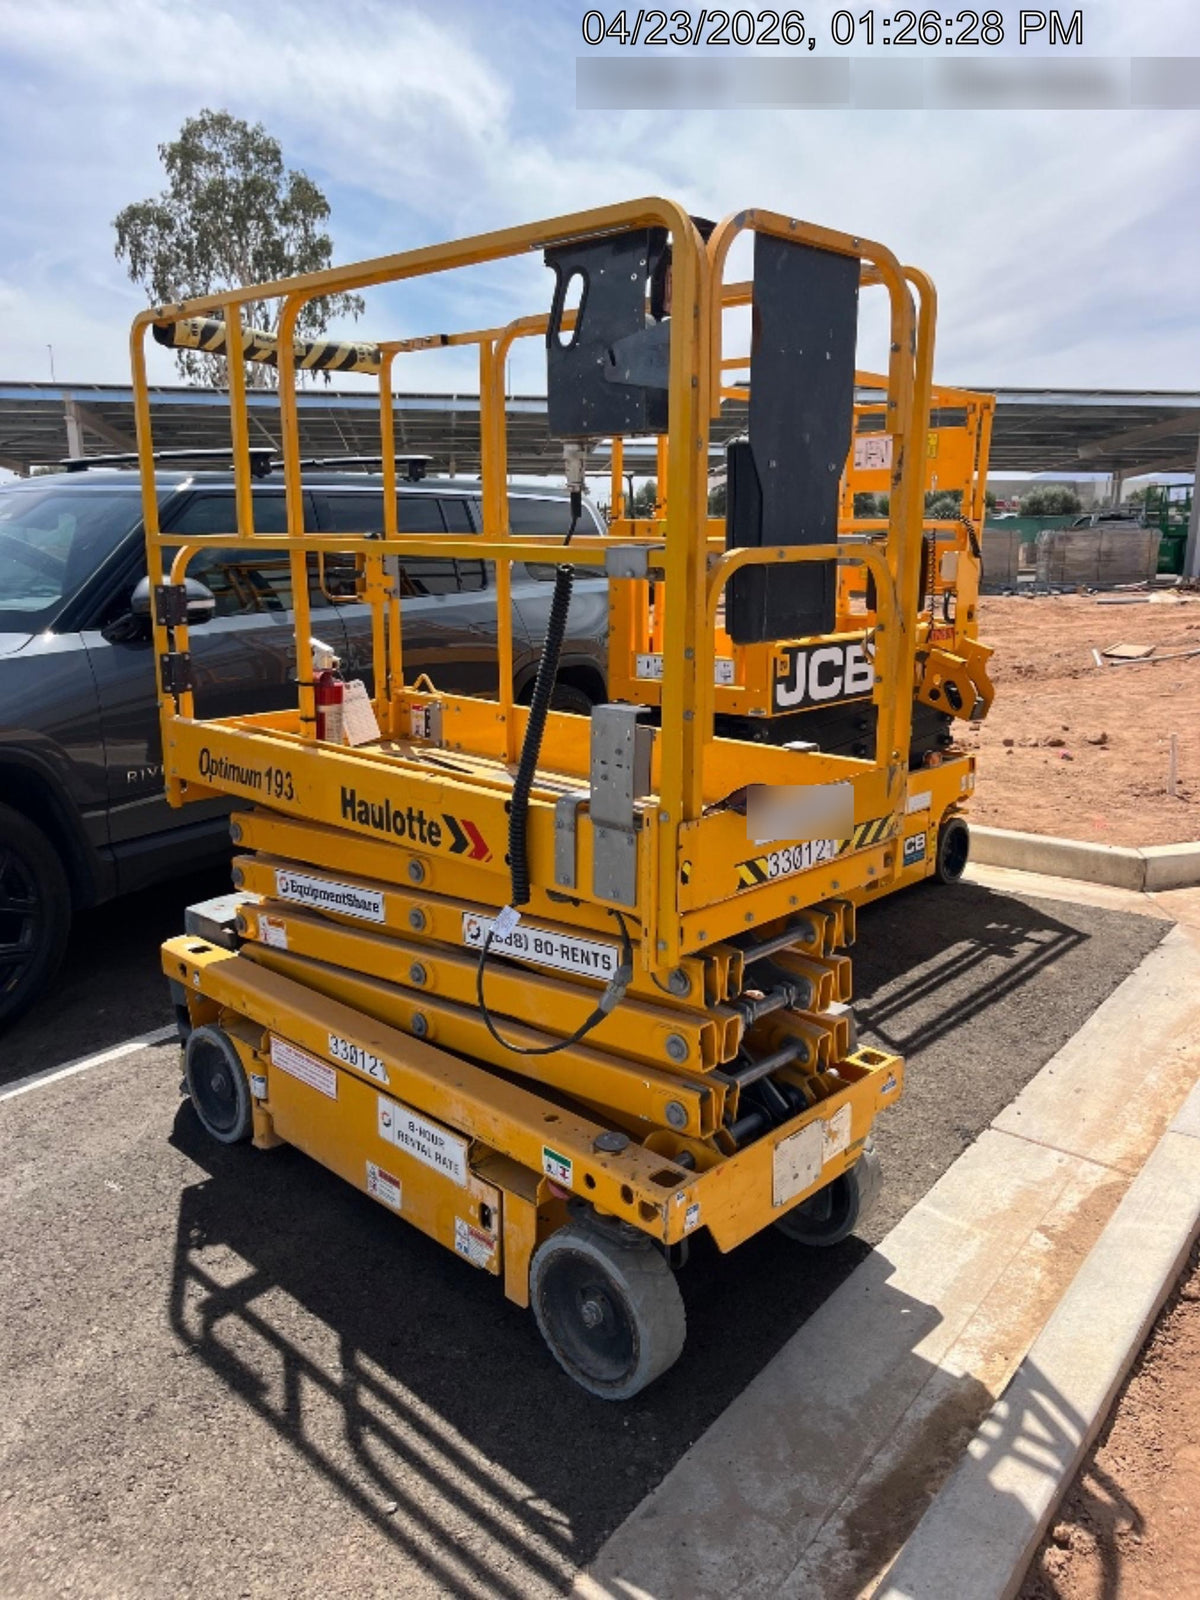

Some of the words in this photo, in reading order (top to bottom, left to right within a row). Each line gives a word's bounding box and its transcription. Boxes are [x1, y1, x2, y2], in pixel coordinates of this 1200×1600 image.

[776, 643, 875, 706] JCB
[127, 764, 164, 783] RIV
[199, 748, 262, 789] Optimum
[265, 766, 294, 800] 193
[341, 786, 441, 847] Haulotte
[291, 880, 380, 913] EquipmentShare
[534, 938, 611, 971] 80-RENTS
[397, 1130, 432, 1159] RENTAL
[435, 1151, 460, 1176] RATE
